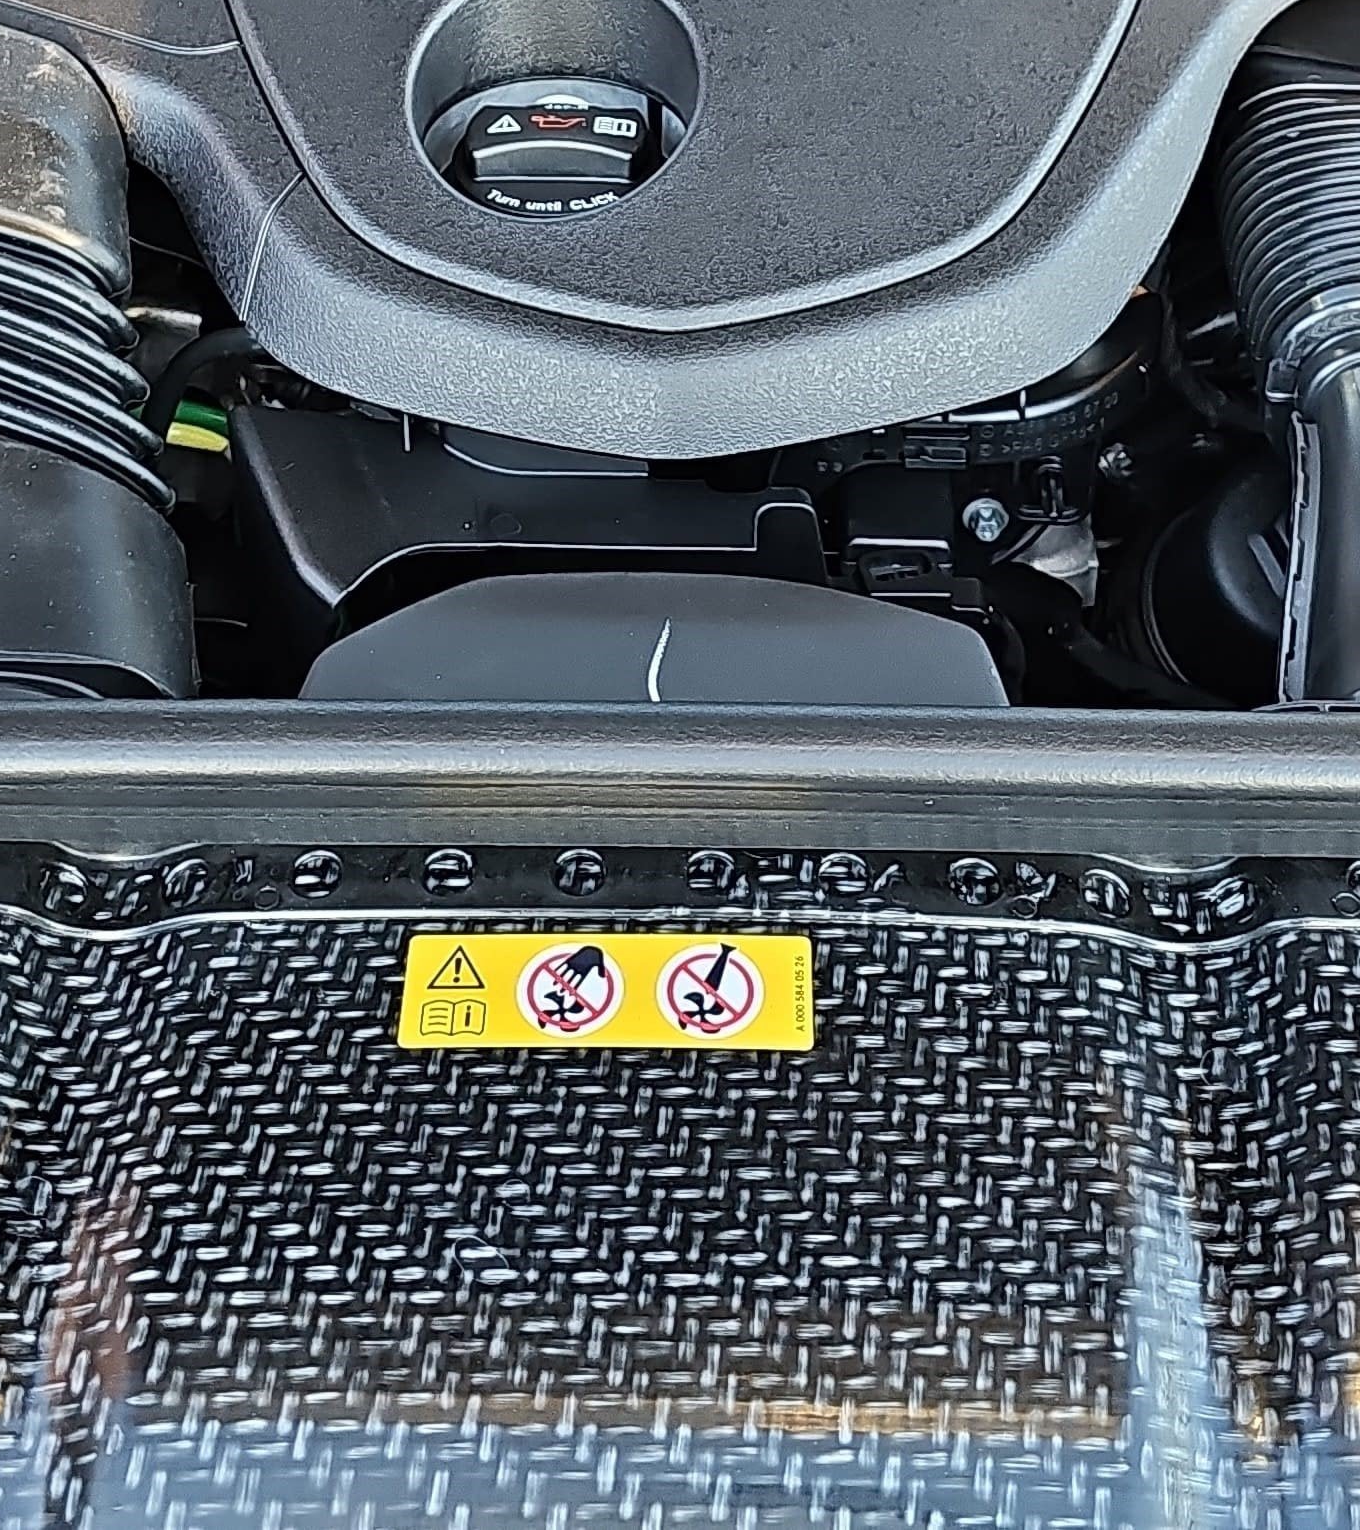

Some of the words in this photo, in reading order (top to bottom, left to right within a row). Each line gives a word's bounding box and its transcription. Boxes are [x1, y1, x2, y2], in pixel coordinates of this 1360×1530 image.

[486, 188, 521, 208] Turn
[525, 200, 562, 212] until
[569, 190, 621, 211] CLICK
[794, 956, 805, 967] 26
[794, 969, 805, 982] 05
[794, 984, 805, 1002] 584
[795, 1004, 806, 1023] 000
[795, 1024, 806, 1032] A
